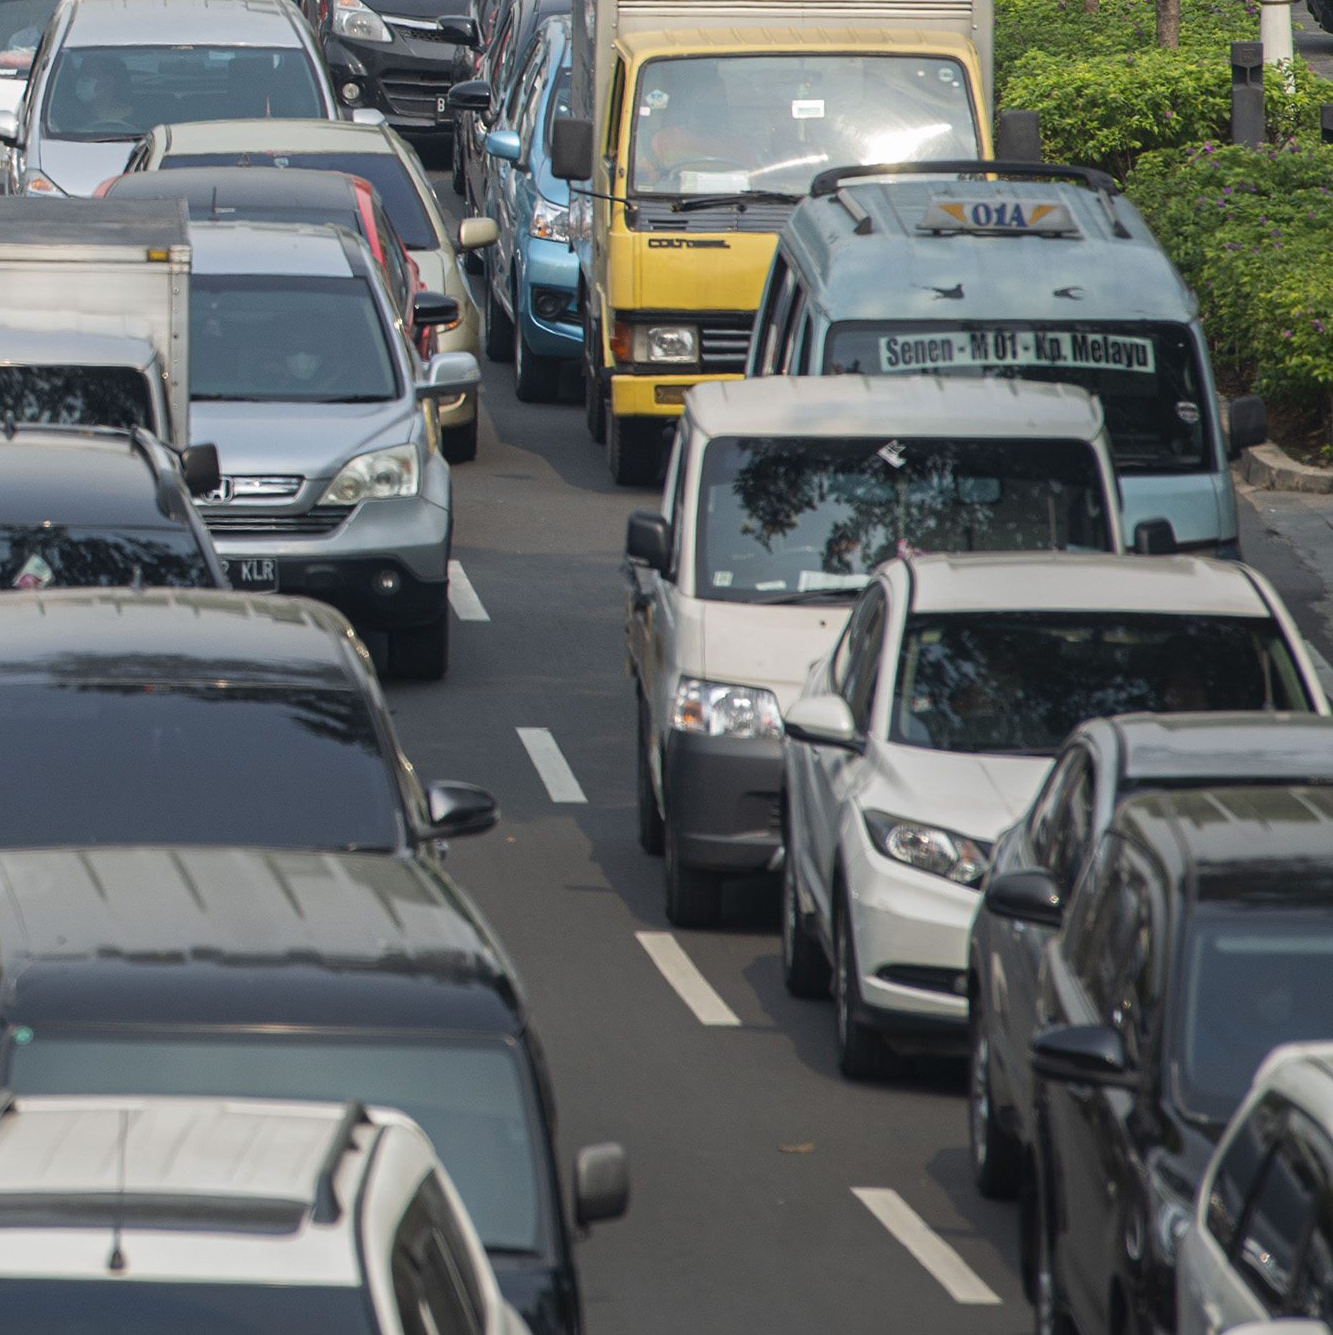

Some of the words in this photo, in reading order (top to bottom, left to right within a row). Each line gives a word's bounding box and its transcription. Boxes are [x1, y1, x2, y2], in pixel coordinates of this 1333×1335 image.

[437, 97, 445, 112] B
[971, 202, 1028, 228] 01A
[886, 336, 954, 368] Senen
[994, 332, 1017, 361] 01
[1071, 334, 1149, 369] Melayu
[241, 560, 275, 582] KLR
